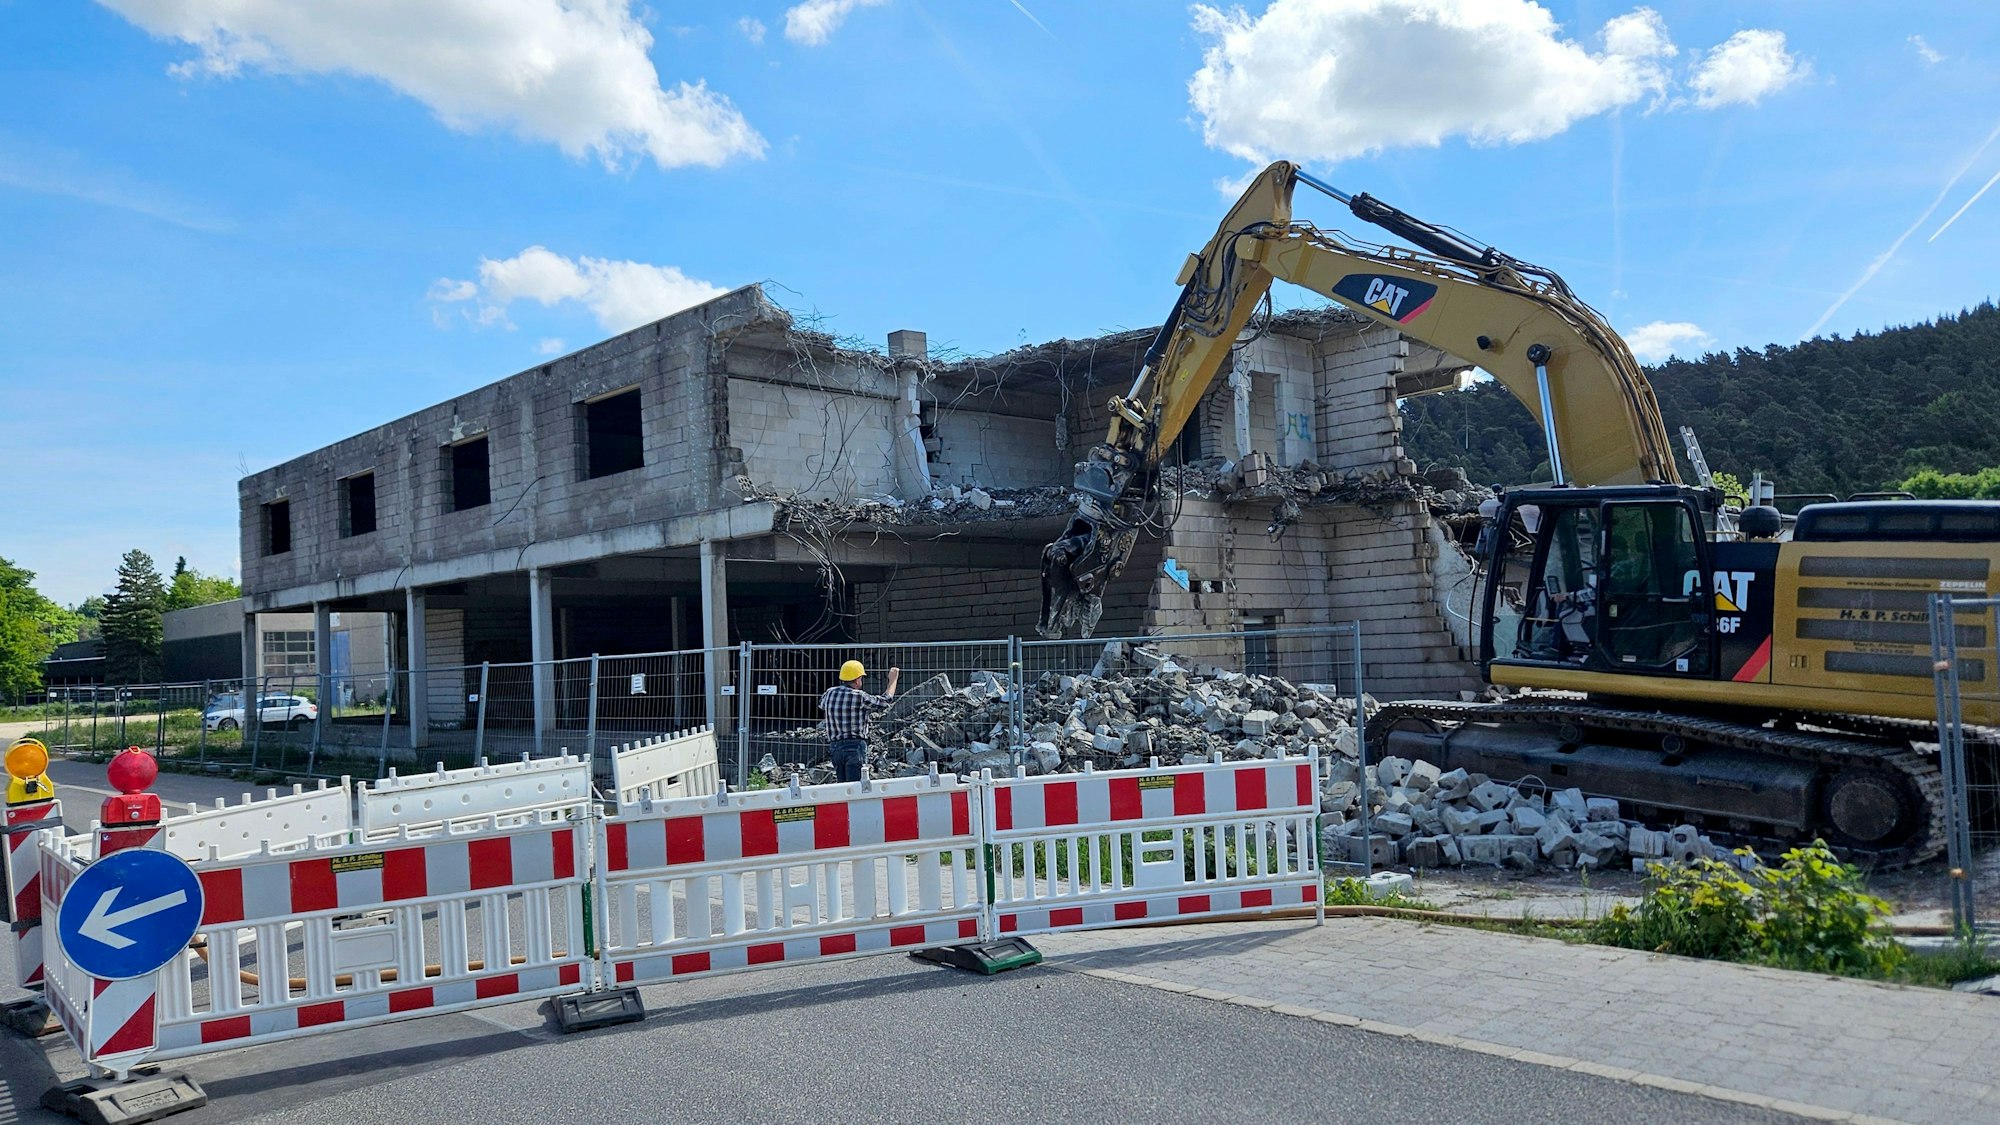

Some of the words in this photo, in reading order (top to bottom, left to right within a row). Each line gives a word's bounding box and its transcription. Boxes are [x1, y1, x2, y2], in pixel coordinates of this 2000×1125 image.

[1364, 277, 1409, 316] CAT
[1683, 570, 1755, 612] CAT
[1716, 616, 1741, 634] 6F
[1840, 610, 1855, 619] H.
[1860, 610, 1870, 620] &
[1875, 611, 1887, 621] P.
